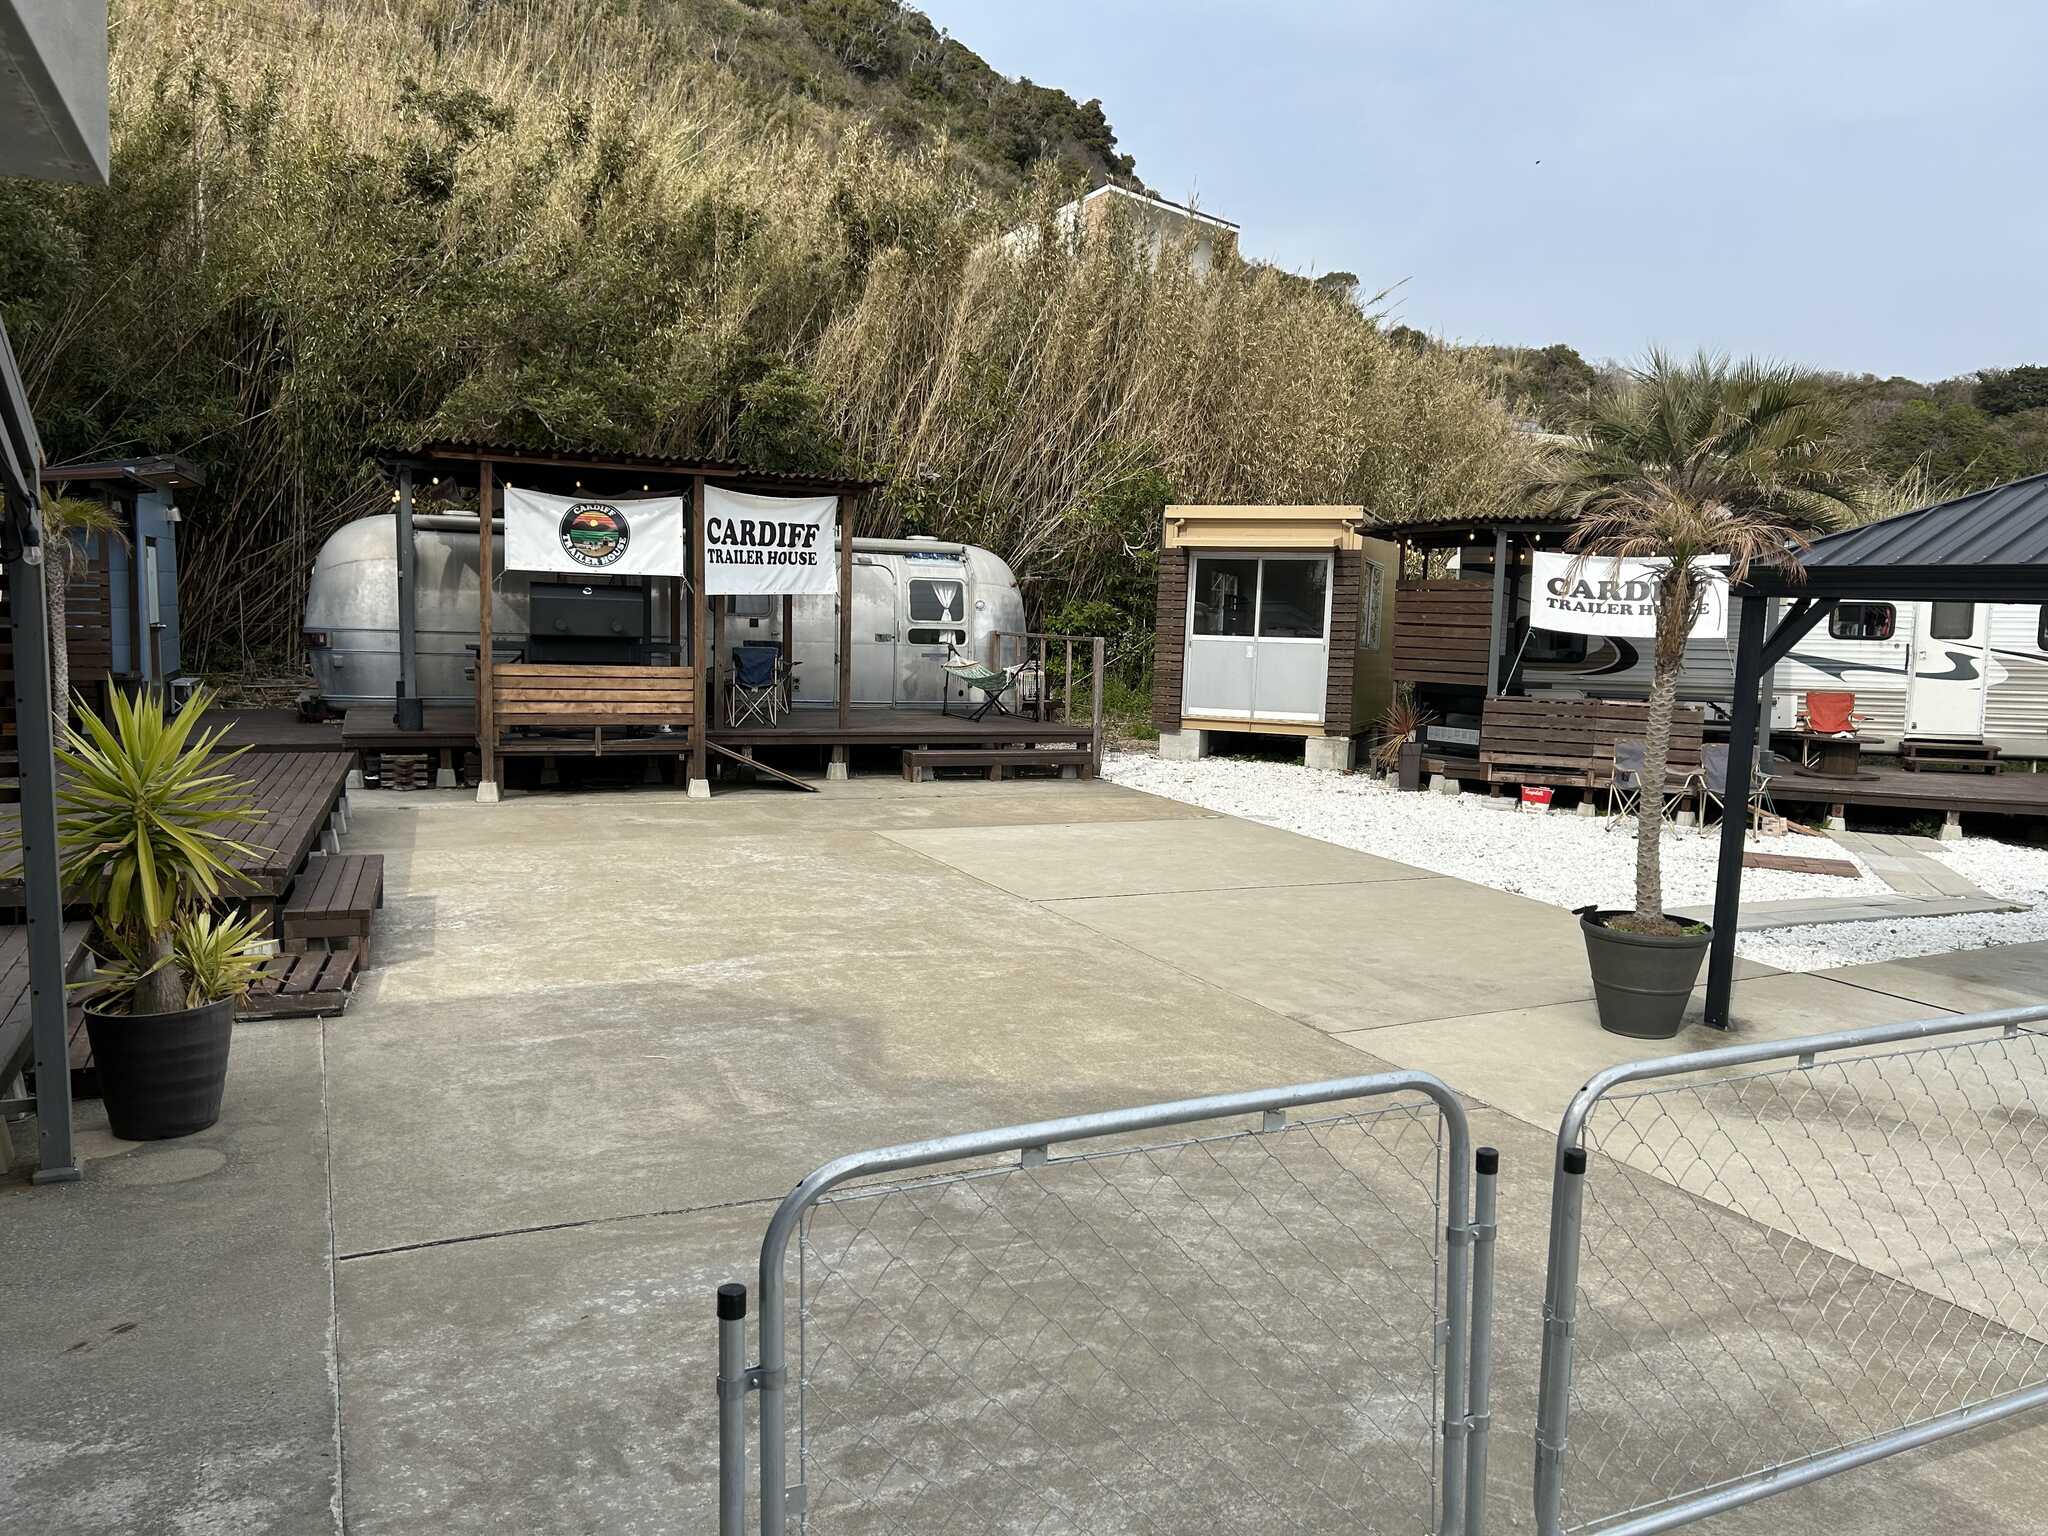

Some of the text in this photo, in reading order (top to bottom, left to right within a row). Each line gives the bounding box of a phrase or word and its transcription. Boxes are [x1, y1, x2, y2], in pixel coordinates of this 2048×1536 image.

[573, 504, 617, 516] CARDIFF
[707, 517, 820, 548] CARDIFF
[562, 533, 627, 565] TRAILER HOUSE
[707, 548, 818, 566] TRAILER HOUSE
[1546, 597, 1633, 616] TRAILER
